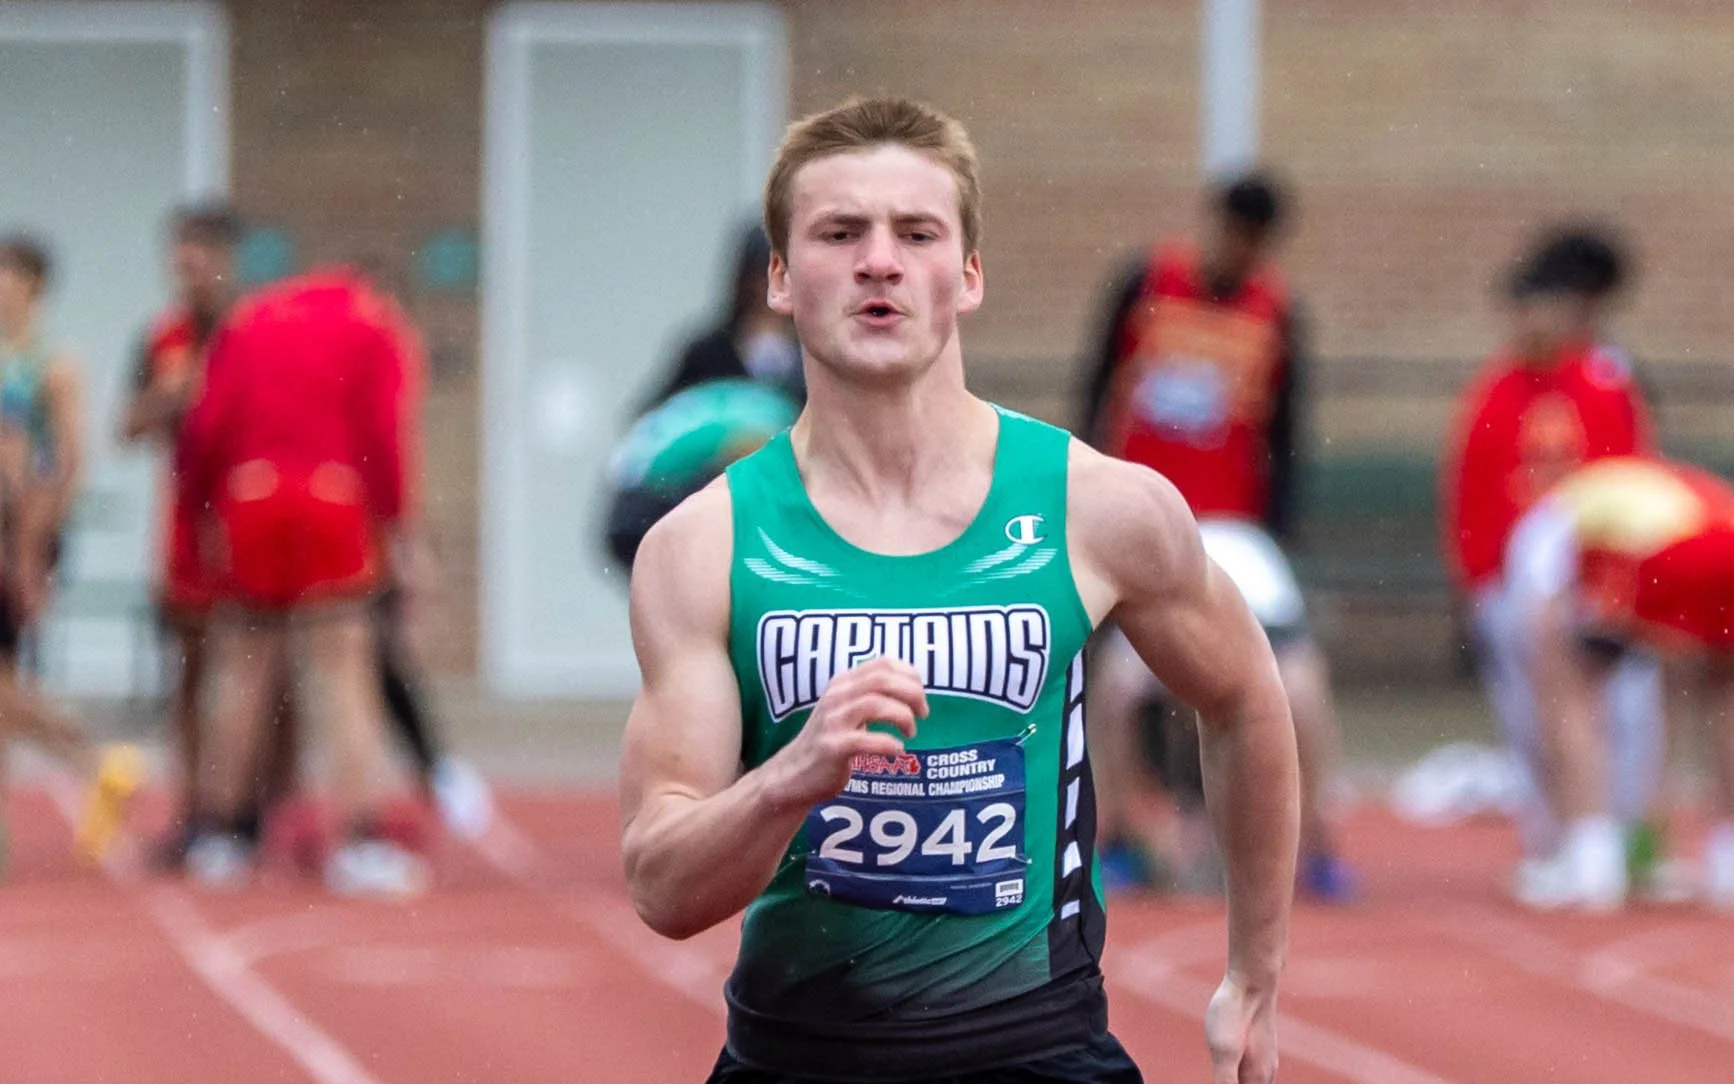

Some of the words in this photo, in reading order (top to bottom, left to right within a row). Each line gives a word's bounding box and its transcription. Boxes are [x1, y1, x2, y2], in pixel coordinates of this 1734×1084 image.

[757, 603, 1051, 723] CAPTAINS
[927, 749, 978, 767] CROSS
[926, 759, 997, 779] COUNTRY
[871, 781, 926, 796] REGIONAL
[928, 773, 1005, 796] CHAMPIONSHIP
[819, 803, 1016, 866] 2942
[995, 894, 1023, 907] 2942
